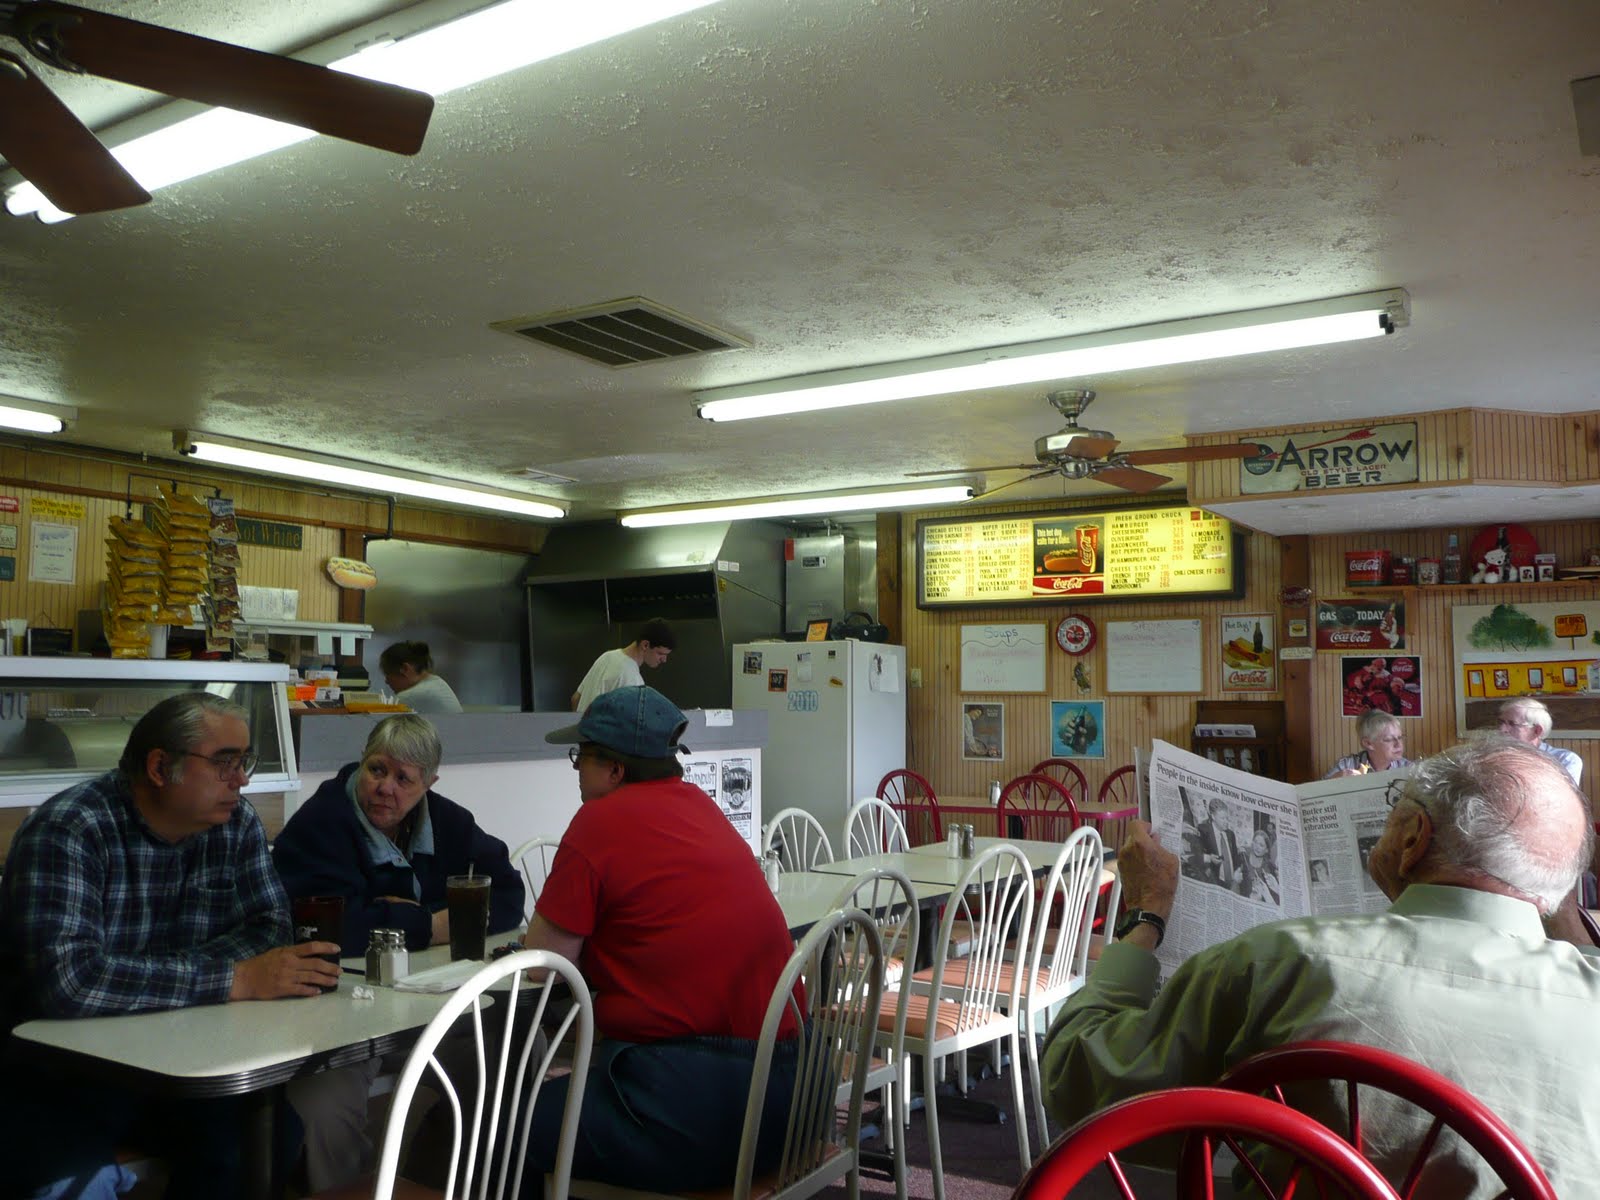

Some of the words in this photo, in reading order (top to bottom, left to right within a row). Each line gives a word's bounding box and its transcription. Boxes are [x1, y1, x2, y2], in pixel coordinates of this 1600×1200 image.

[1275, 439, 1413, 472] ARROW
[1323, 467, 1352, 475] STYLE
[1356, 464, 1387, 472] LAGER
[1305, 471, 1382, 488] BEER
[1161, 511, 1183, 519] CHUCK
[261, 523, 300, 547] Whine
[1037, 529, 1047, 537] This
[1054, 528, 1062, 538] dog
[1191, 530, 1221, 538] LEMONADE
[1349, 558, 1381, 571] Coca-Cola
[1052, 577, 1083, 590] Coca-Cola
[1319, 611, 1337, 621] GAS
[984, 627, 1019, 644] Soups
[1330, 630, 1373, 643] Coca-Cola
[1229, 671, 1269, 684] Coca-Cola
[787, 690, 819, 712] 2010
[1179, 772, 1186, 783] in
[1186, 774, 1198, 786] the
[1199, 777, 1220, 794] inside
[1220, 783, 1240, 799] know
[1240, 789, 1257, 805] how
[1257, 794, 1279, 812] clever
[1279, 800, 1292, 815] she
[1301, 808, 1322, 817] Butler
[1324, 804, 1338, 814] still
[1303, 815, 1319, 825] feels
[1319, 813, 1337, 824] good
[1303, 821, 1340, 832] vibrations
